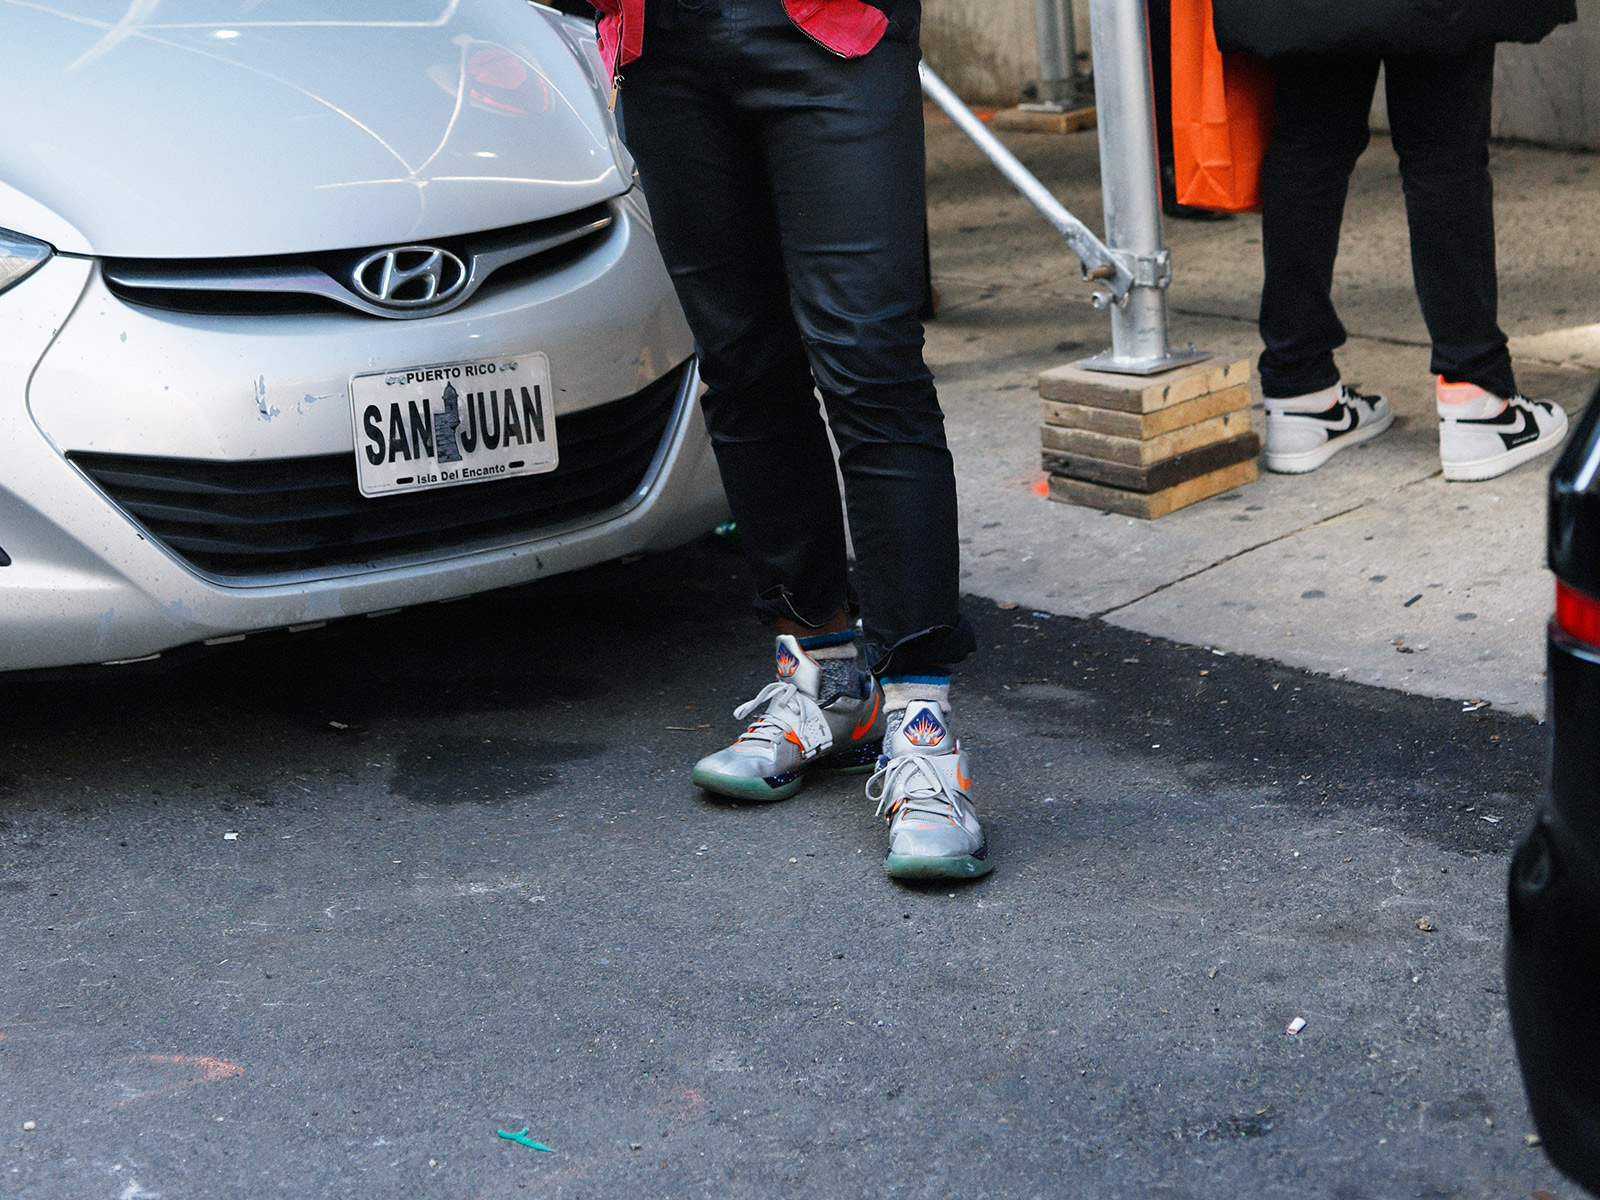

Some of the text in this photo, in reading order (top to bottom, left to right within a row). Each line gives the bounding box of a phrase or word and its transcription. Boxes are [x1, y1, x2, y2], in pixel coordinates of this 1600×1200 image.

[406, 363, 496, 384] PUERTO RICO
[363, 385, 546, 466] SAN JUAN
[417, 464, 506, 484] Isla Del Encanto
